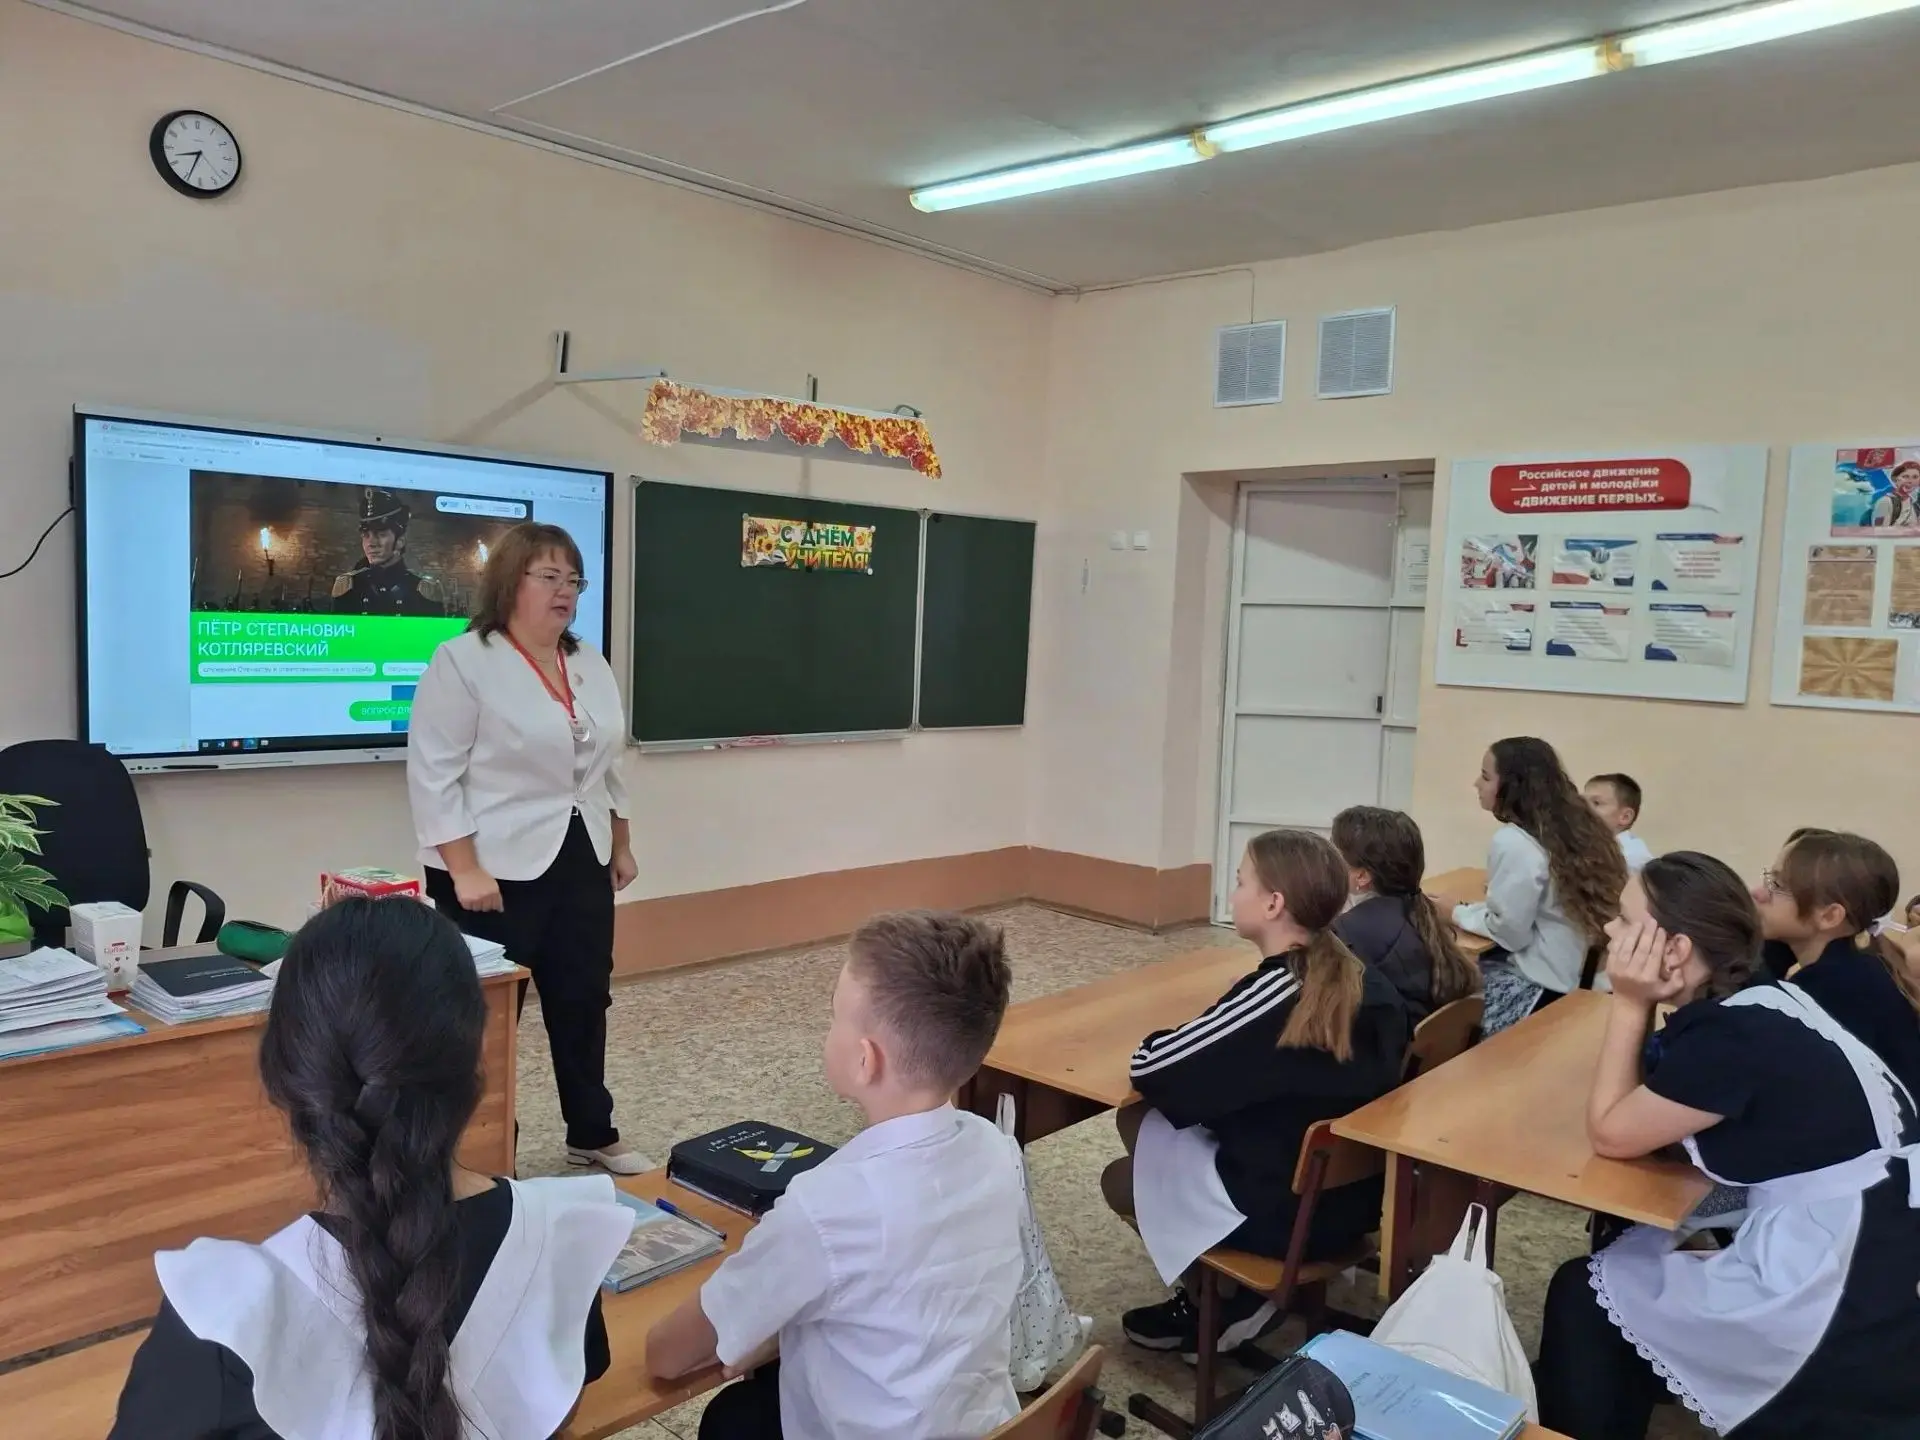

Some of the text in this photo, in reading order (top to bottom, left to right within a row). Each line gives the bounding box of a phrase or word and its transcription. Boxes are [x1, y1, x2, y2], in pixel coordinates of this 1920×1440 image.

[1518, 466, 1660, 481] Российское движение
[1540, 478, 1659, 492] детей и молодёжи
[1513, 493, 1665, 508] «ДВИЖЕНИЕ ПЕРВЫХ»
[781, 526, 854, 547] С ДНЁМ
[785, 545, 869, 569] УЧИТЕЛЯ!
[198, 619, 355, 637] ПЁТР СТЕПАНОВИЧ
[198, 640, 329, 656] КОТЛЯРЕВСКИЙ
